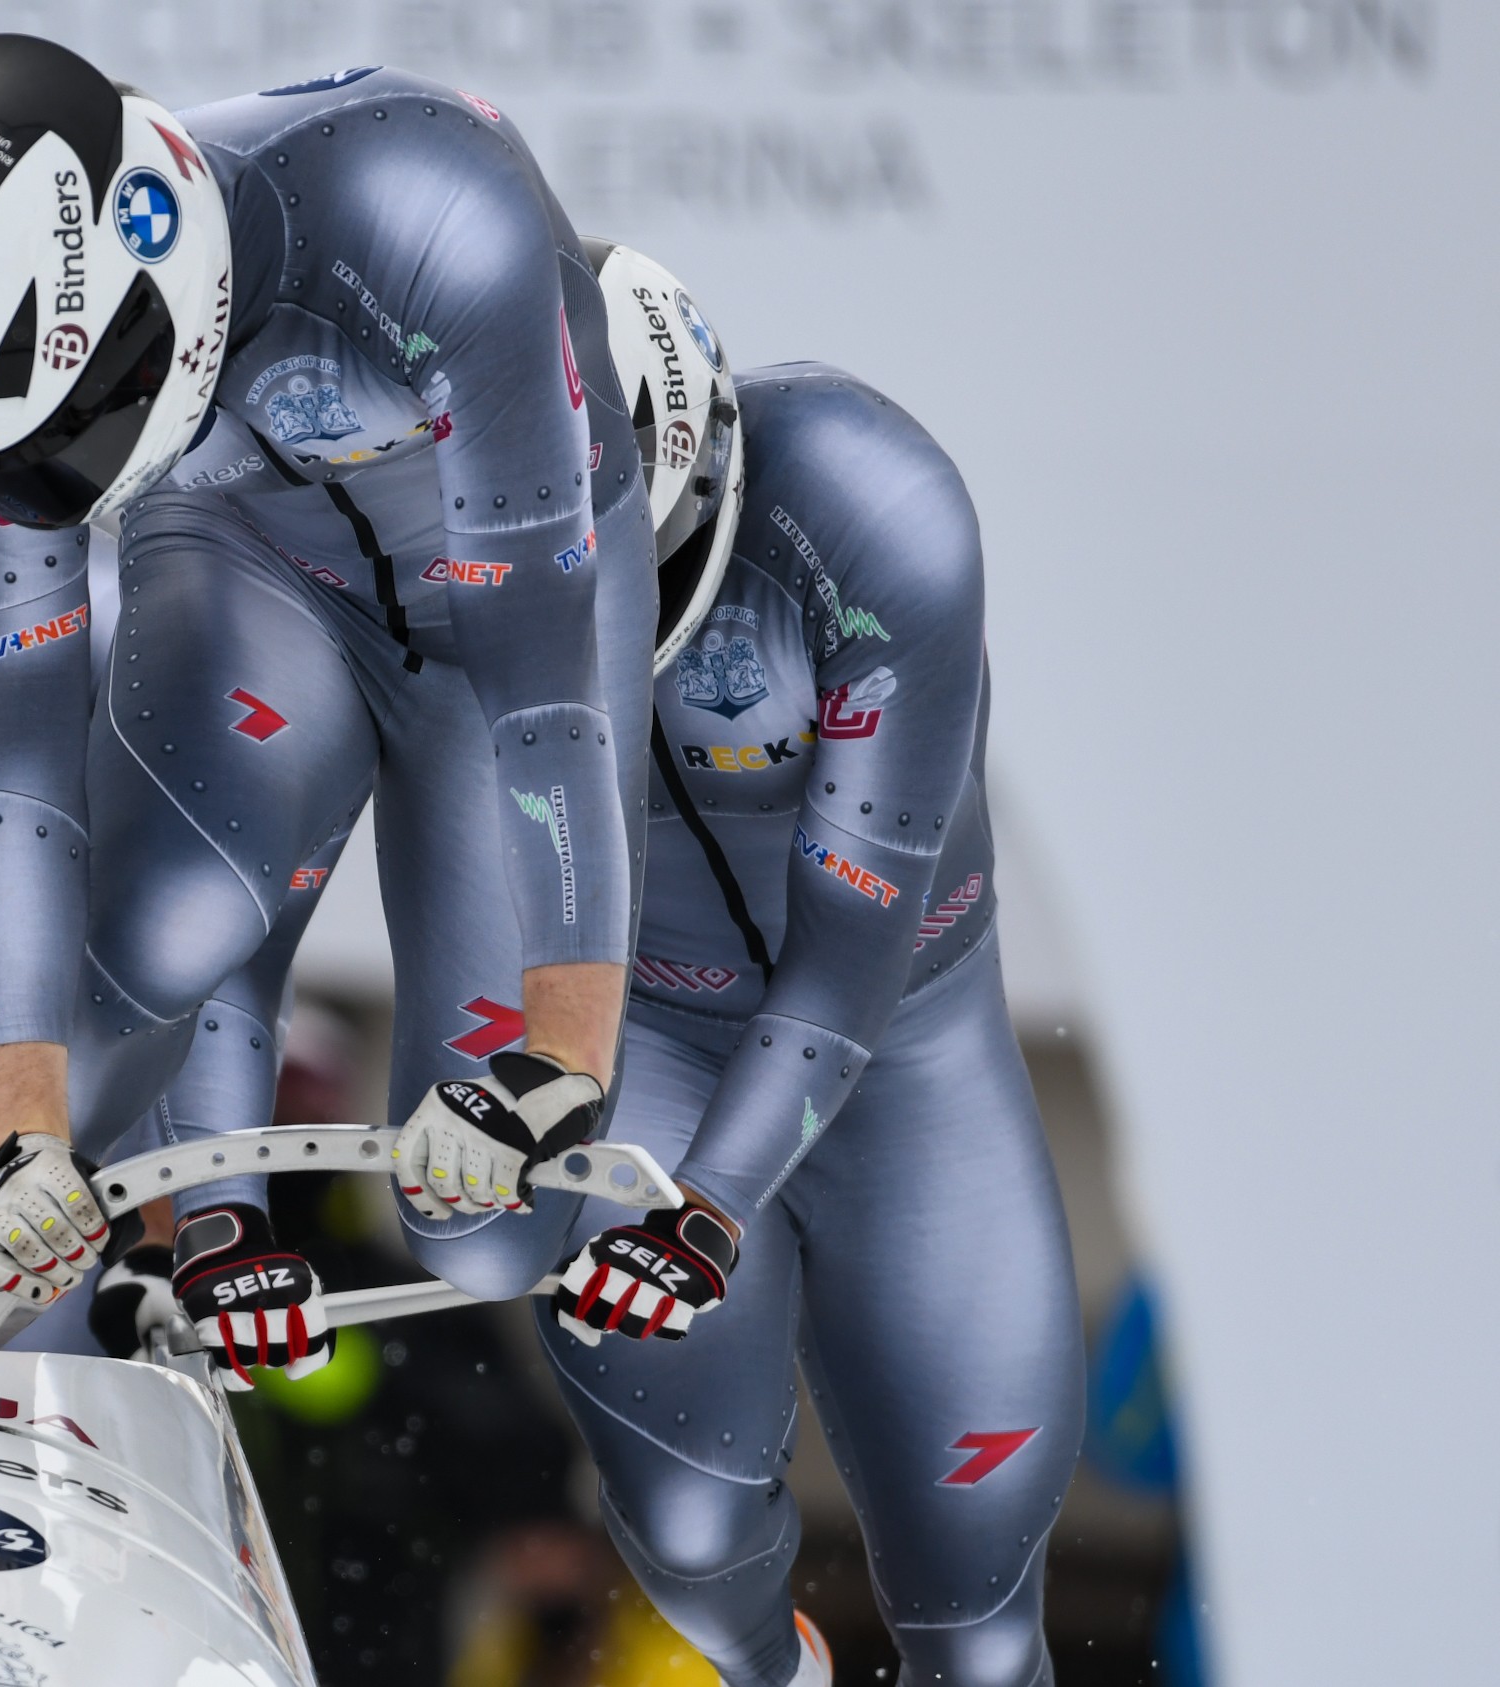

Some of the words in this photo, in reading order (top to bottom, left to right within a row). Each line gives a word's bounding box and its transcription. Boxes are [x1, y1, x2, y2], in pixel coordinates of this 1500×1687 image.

[54, 169, 85, 315] Binders
[632, 287, 688, 413] Binders
[247, 355, 300, 404] FREEPORT
[299, 355, 315, 369] OF
[315, 357, 341, 379] RIGA
[770, 505, 821, 569] LATVIJAS
[33, 603, 90, 645] NET
[715, 606, 732, 620] OF
[733, 607, 759, 631] RIGA
[680, 738, 799, 772] RECK
[556, 820, 573, 867] VALSTS
[561, 866, 576, 924] LATVIJAS
[836, 859, 900, 909] NET
